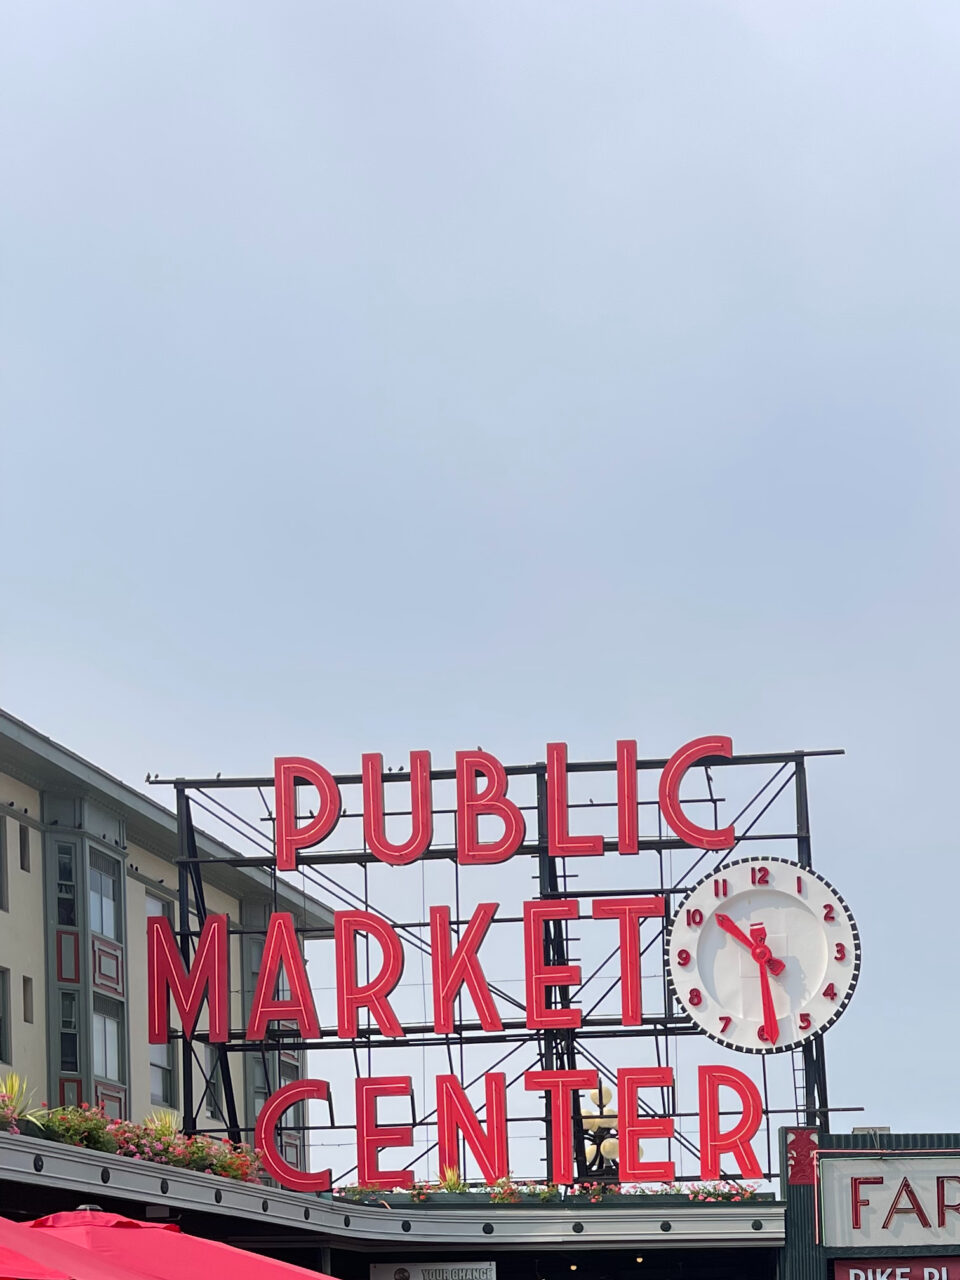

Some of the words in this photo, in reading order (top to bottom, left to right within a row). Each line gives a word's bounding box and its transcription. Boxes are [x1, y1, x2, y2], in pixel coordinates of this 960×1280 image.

[274, 736, 736, 871] PUBLIC
[751, 867, 769, 885] 12
[796, 876, 801, 894] 1
[714, 879, 728, 897] 11
[686, 909, 704, 927] 10
[823, 904, 835, 922] 2
[677, 949, 691, 967] 9
[834, 943, 846, 961] 3
[147, 897, 666, 1045] MARKET
[689, 988, 703, 1006] 8
[822, 983, 837, 1001] 4
[719, 1016, 732, 1033] 7
[799, 1013, 811, 1029] 5
[254, 1065, 763, 1193] CENTER
[421, 1268, 450, 1280] YOUR
[451, 1268, 493, 1280] CHANGE
